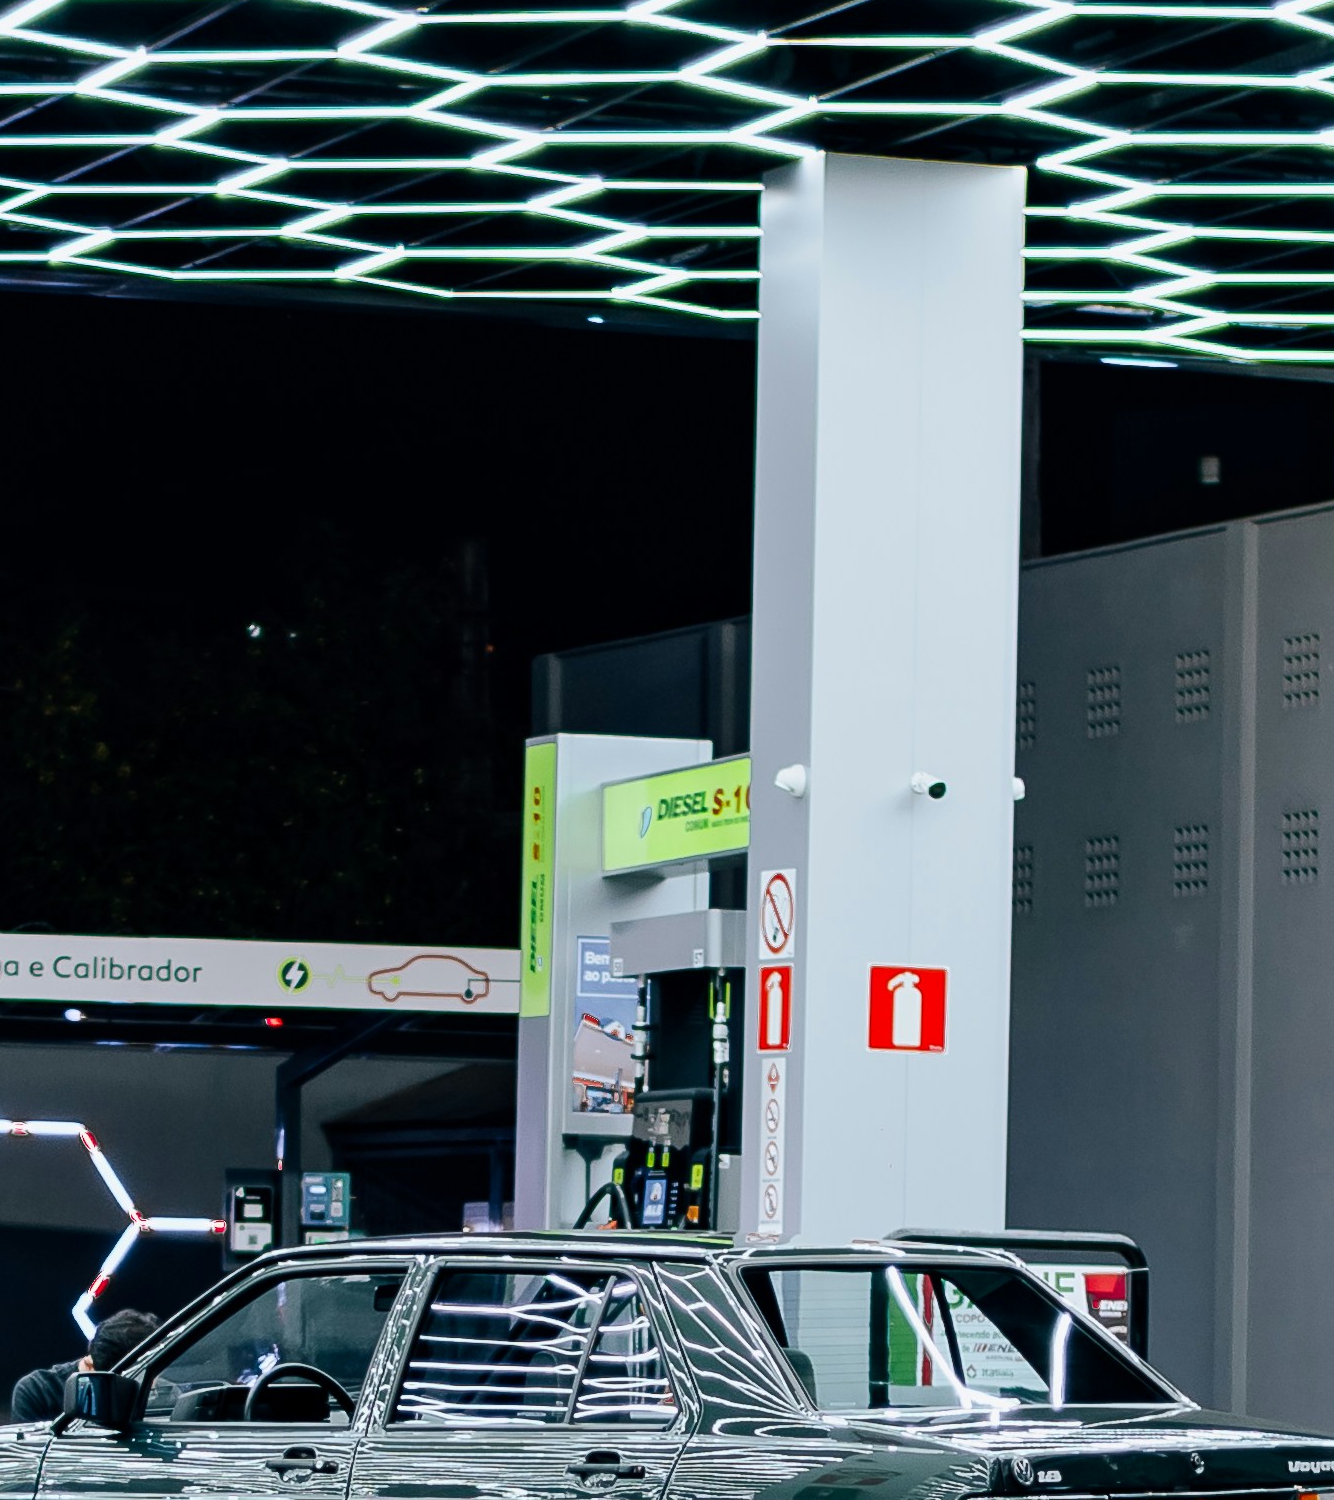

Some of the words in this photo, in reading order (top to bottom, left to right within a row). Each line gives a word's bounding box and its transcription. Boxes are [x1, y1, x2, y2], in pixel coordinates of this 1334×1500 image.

[656, 790, 708, 821] DIESEL
[29, 960, 44, 977] e
[53, 956, 203, 983] Calibrador
